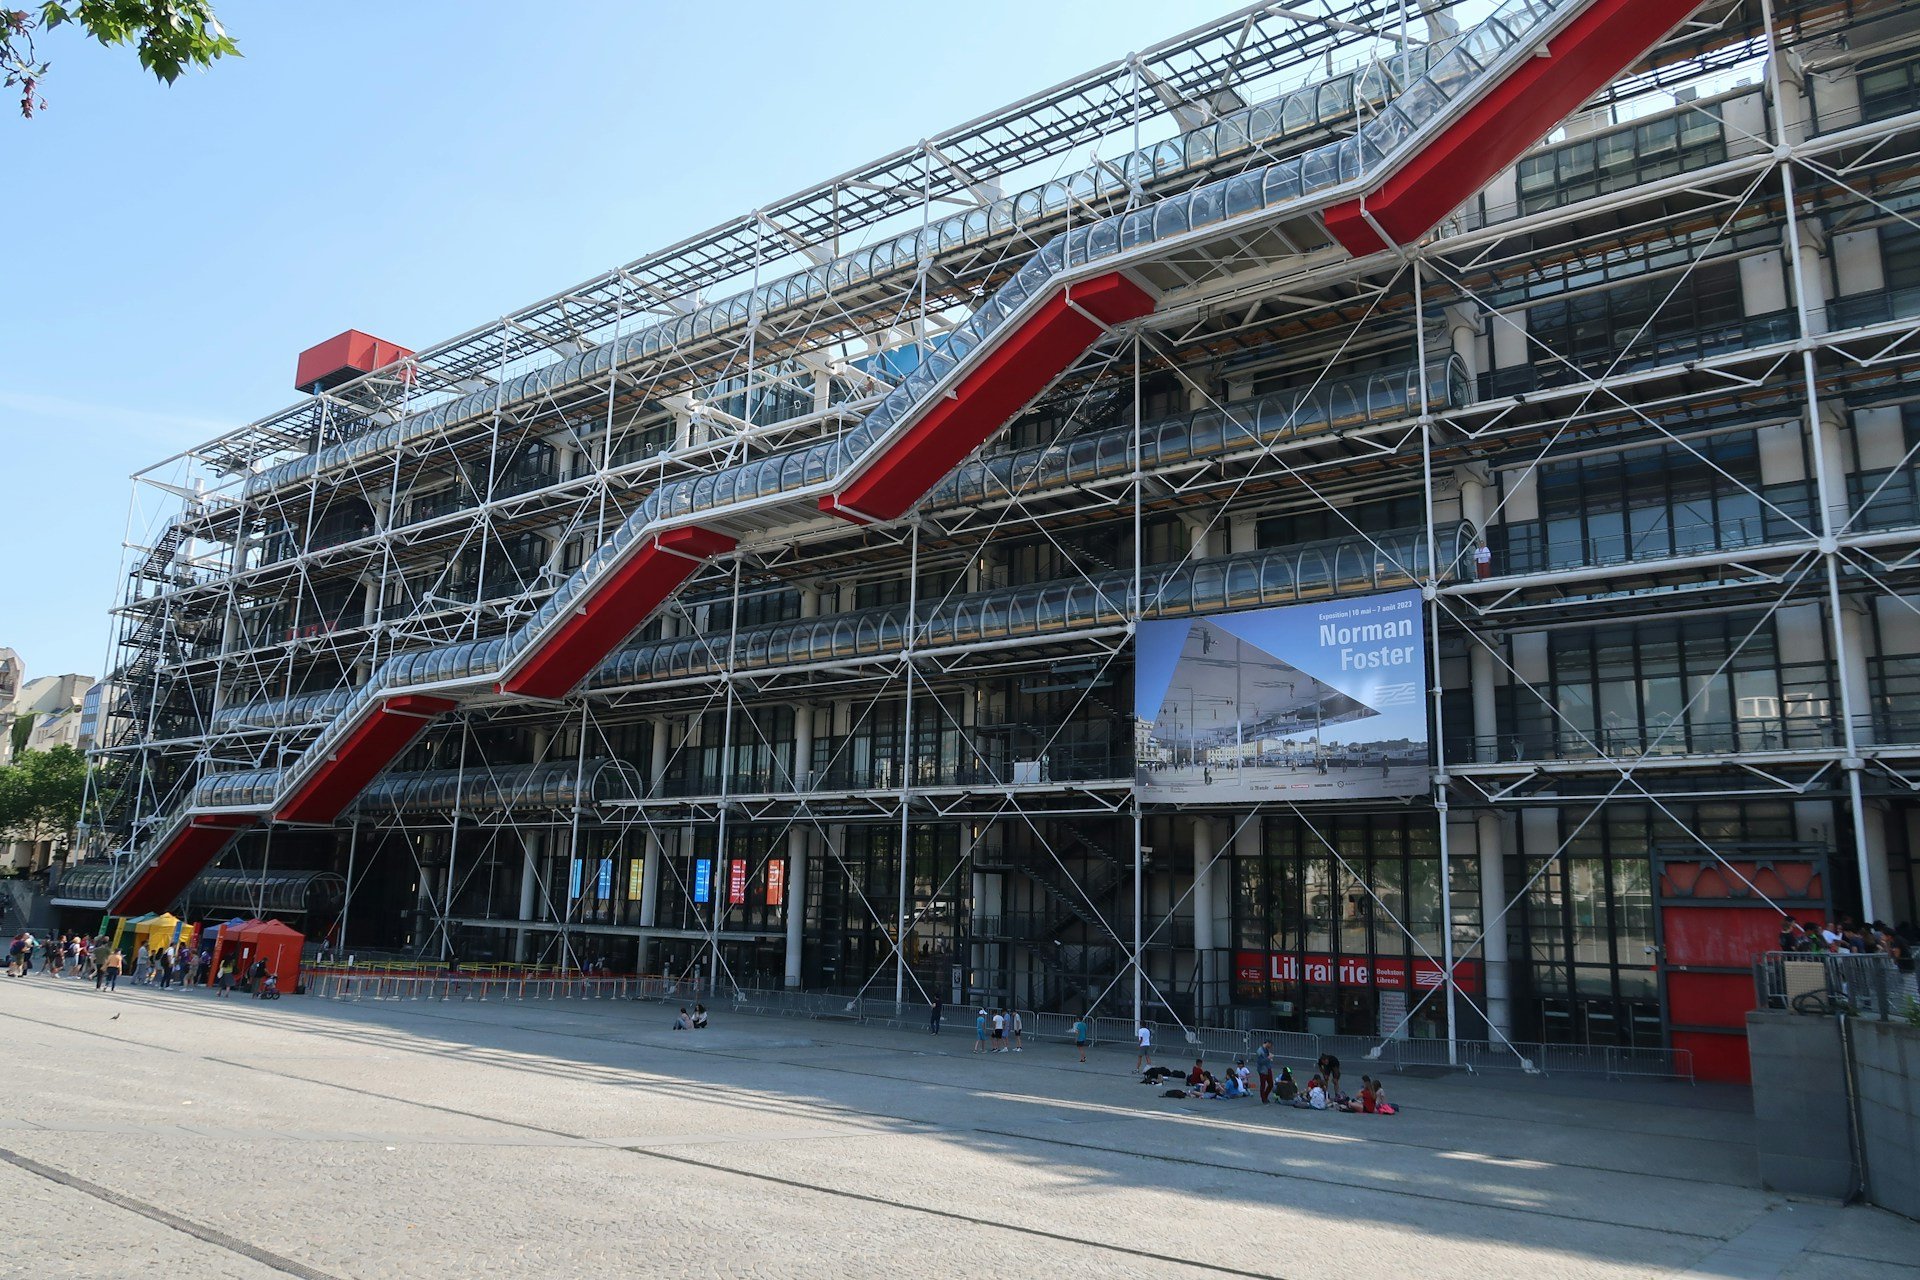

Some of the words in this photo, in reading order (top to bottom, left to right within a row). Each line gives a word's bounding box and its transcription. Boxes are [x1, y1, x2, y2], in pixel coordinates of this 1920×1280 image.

[1319, 611, 1348, 620] Exposition
[1352, 608, 1359, 616] 10
[1397, 600, 1413, 610] 2023
[1320, 618, 1412, 647] Norman
[1341, 646, 1414, 670] Foster
